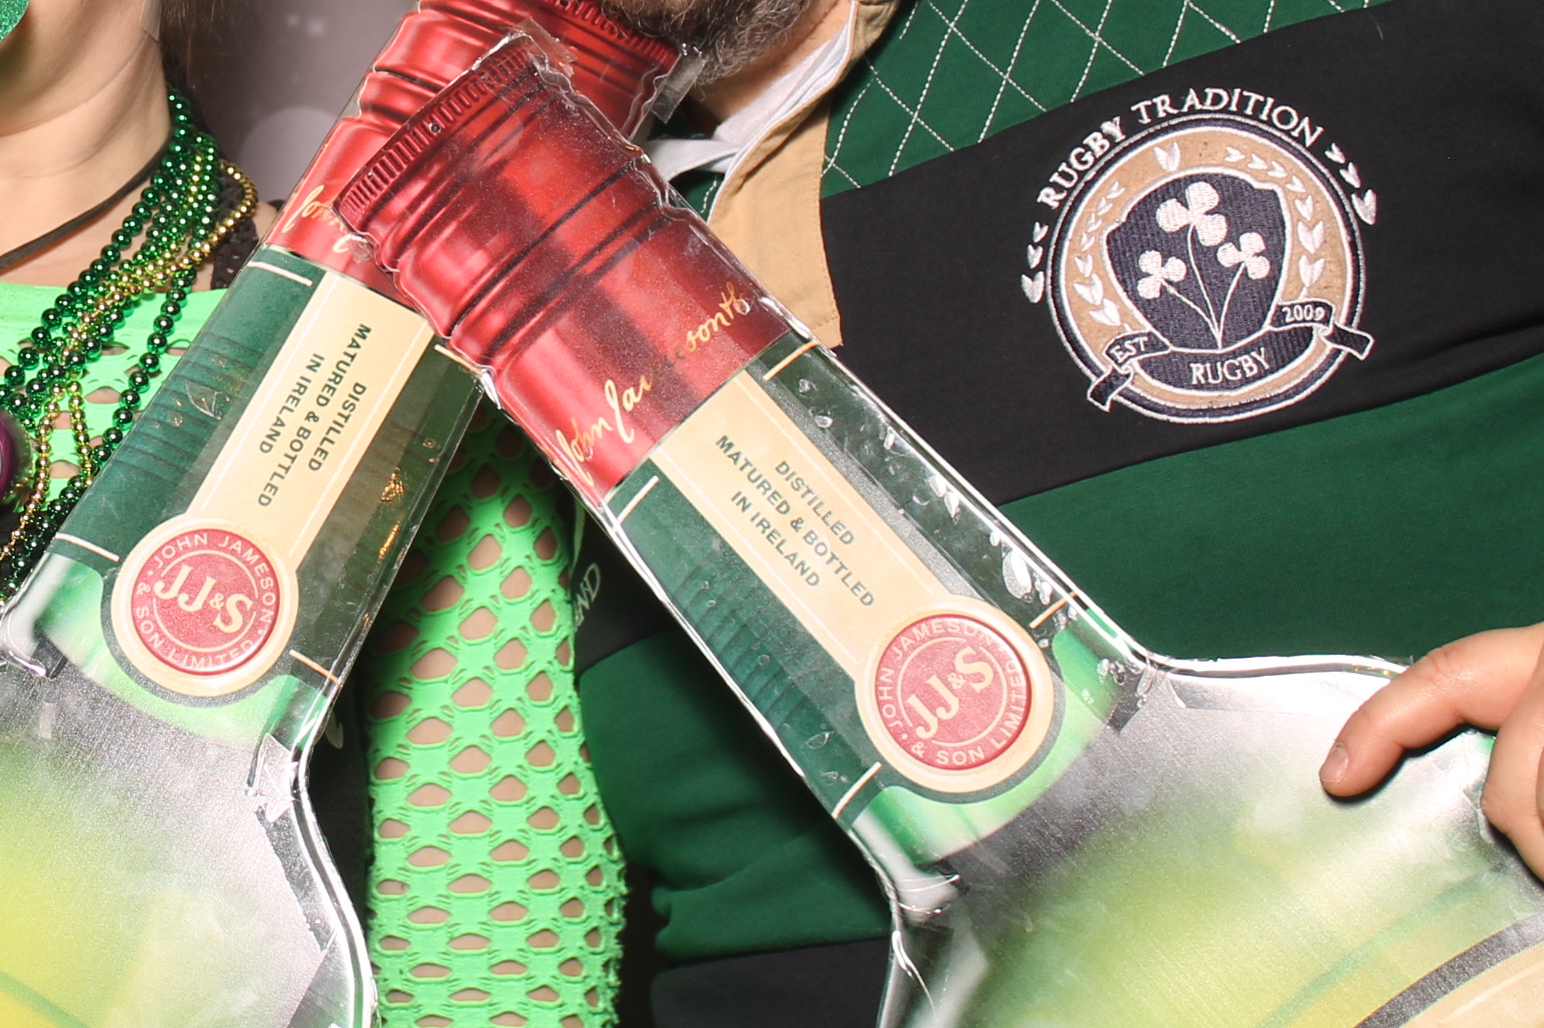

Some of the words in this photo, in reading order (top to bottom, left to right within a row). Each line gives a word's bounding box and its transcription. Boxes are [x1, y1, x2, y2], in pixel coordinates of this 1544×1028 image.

[1037, 115, 1127, 210] RUGBY
[1131, 87, 1324, 148] TRADITION
[1110, 334, 1149, 363] EST
[1281, 304, 1326, 323] 2009
[305, 352, 325, 373] IN
[315, 323, 372, 407] MATURED
[1189, 346, 1271, 386] RUGBY
[259, 375, 312, 454] IRELAND
[304, 410, 320, 423] &
[308, 381, 368, 472] DISTILLED
[258, 426, 312, 507] BOTTLED
[715, 434, 791, 516] MATURED
[789, 516, 805, 533] &
[802, 529, 875, 607] BOTTLED
[775, 459, 855, 546] DISTILLED
[730, 490, 752, 513] IN
[750, 511, 821, 588] IRELAND
[135, 581, 151, 596] &
[153, 532, 208, 570] JOHN
[219, 535, 277, 624] JAMESON
[135, 606, 165, 649] SON
[166, 639, 255, 669] LIMITED
[891, 620, 995, 660] JAMESON
[879, 667, 904, 728] JOHN
[911, 740, 926, 758] &
[935, 745, 986, 766] SON
[990, 660, 1028, 750] LIMITED
